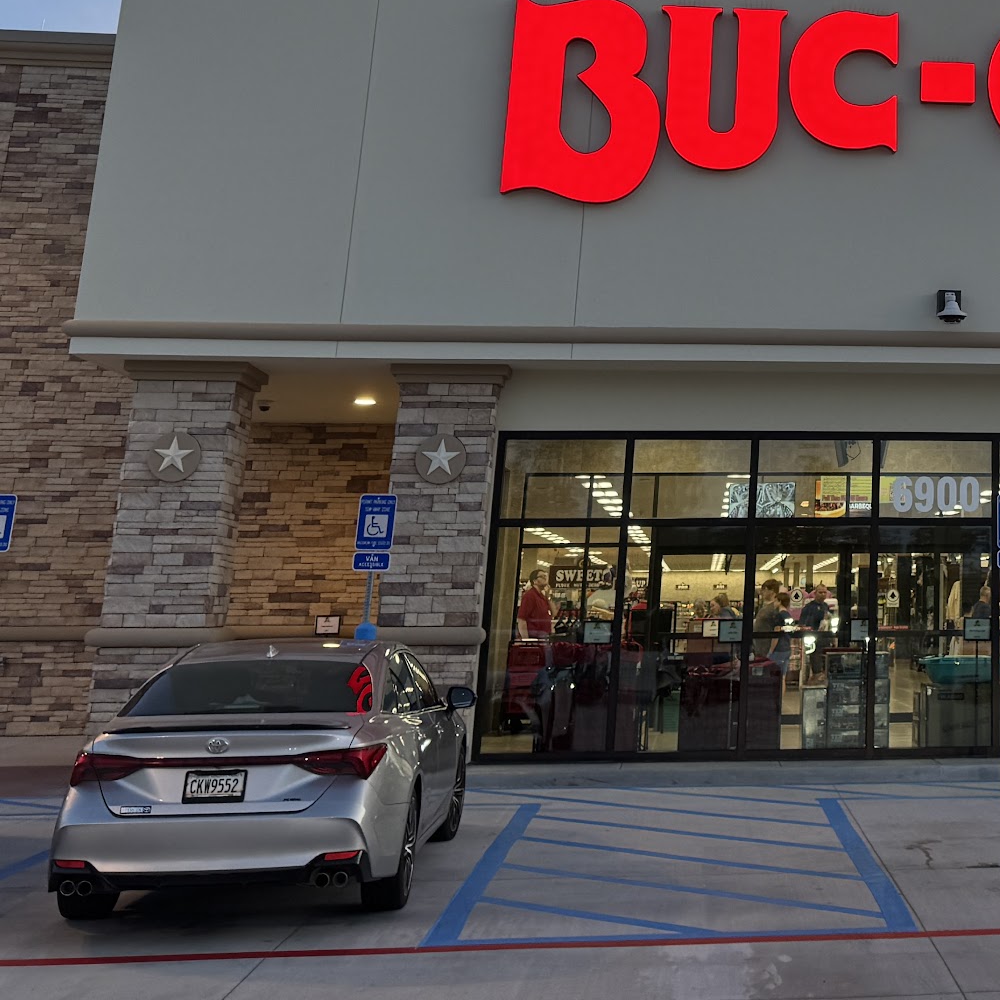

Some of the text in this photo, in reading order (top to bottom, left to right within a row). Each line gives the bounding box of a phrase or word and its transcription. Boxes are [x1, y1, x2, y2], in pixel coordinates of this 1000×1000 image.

[892, 476, 980, 513] 6900
[555, 569, 609, 582] SWEET
[189, 777, 240, 795] CKW9552
